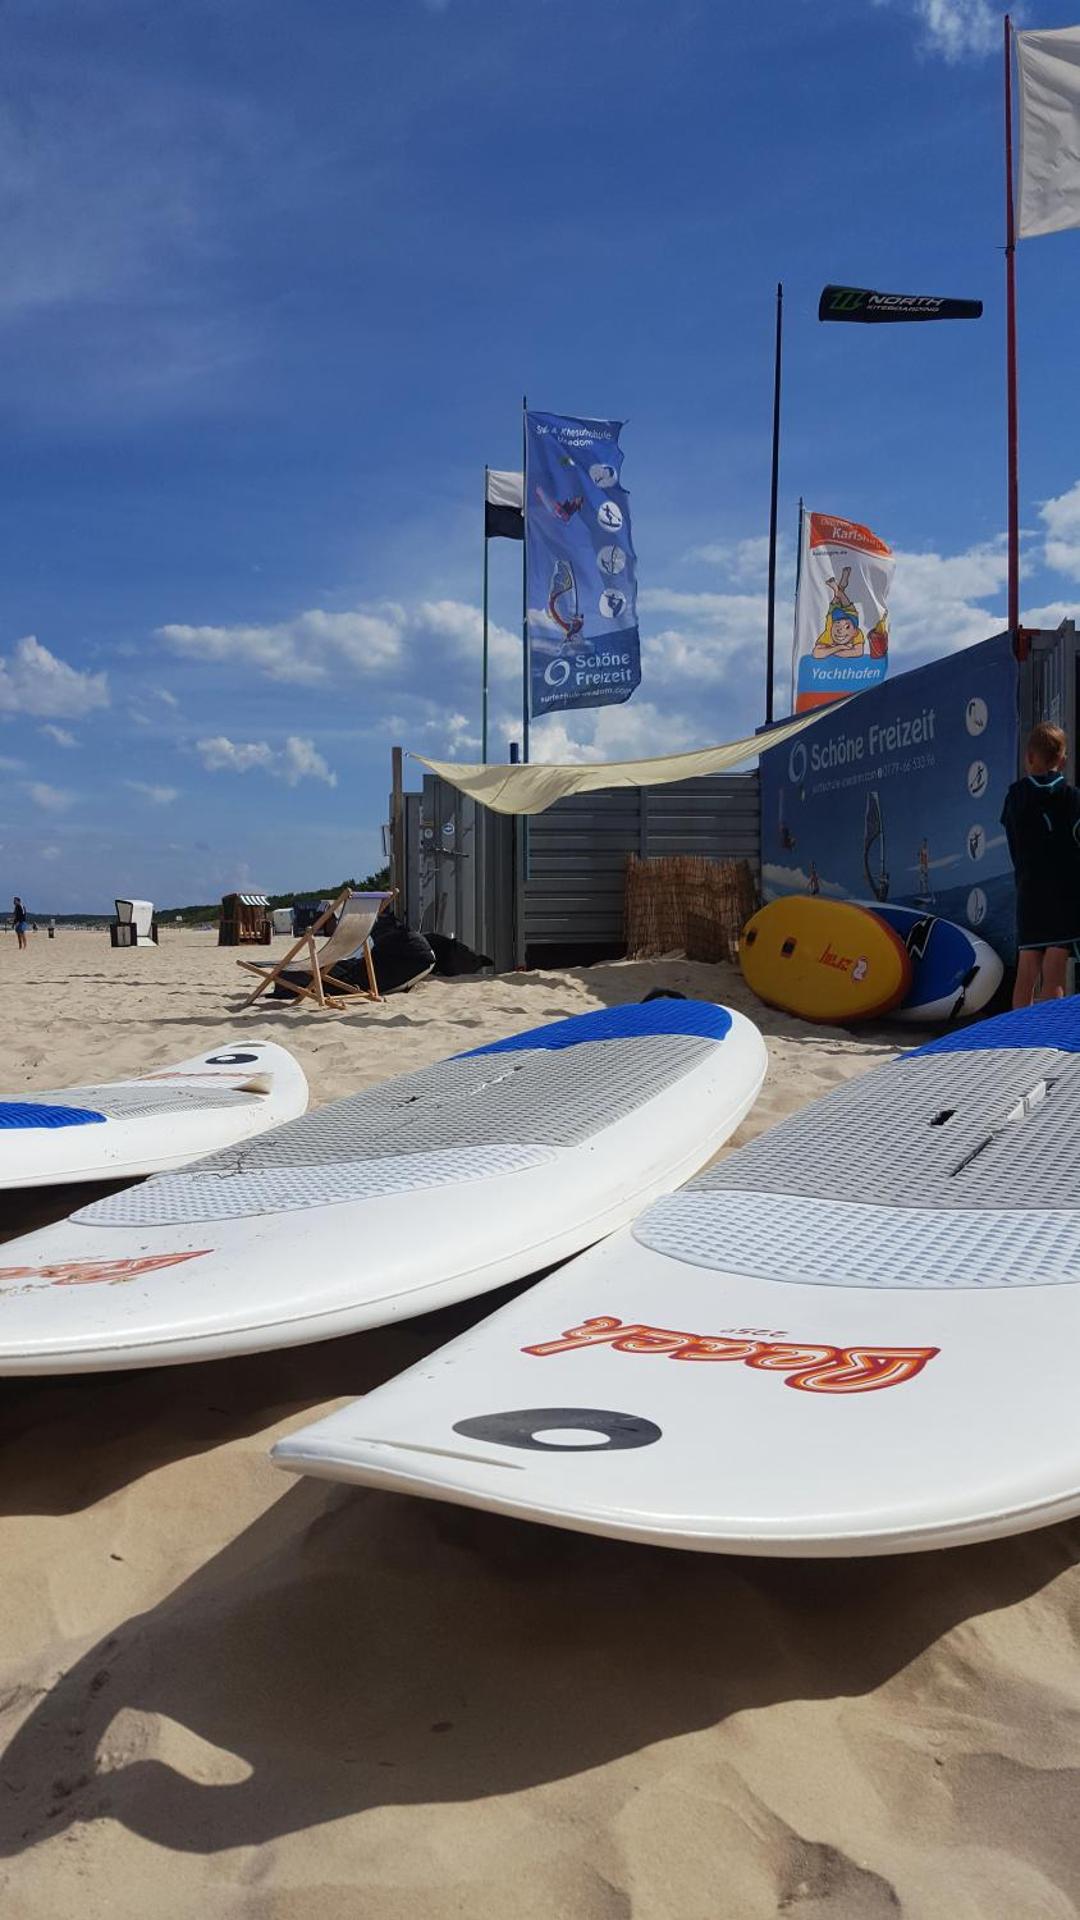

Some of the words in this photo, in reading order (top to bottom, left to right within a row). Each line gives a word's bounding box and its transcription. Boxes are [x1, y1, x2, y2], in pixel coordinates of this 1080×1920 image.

[868, 295, 945, 306] NORTH
[575, 652, 630, 668] Schöne
[575, 668, 632, 685] Freizeit
[812, 667, 881, 680] Yachthafen
[810, 734, 864, 771] Schöne
[869, 708, 936, 755] Freizeit
[520, 1315, 941, 1394] Beach
